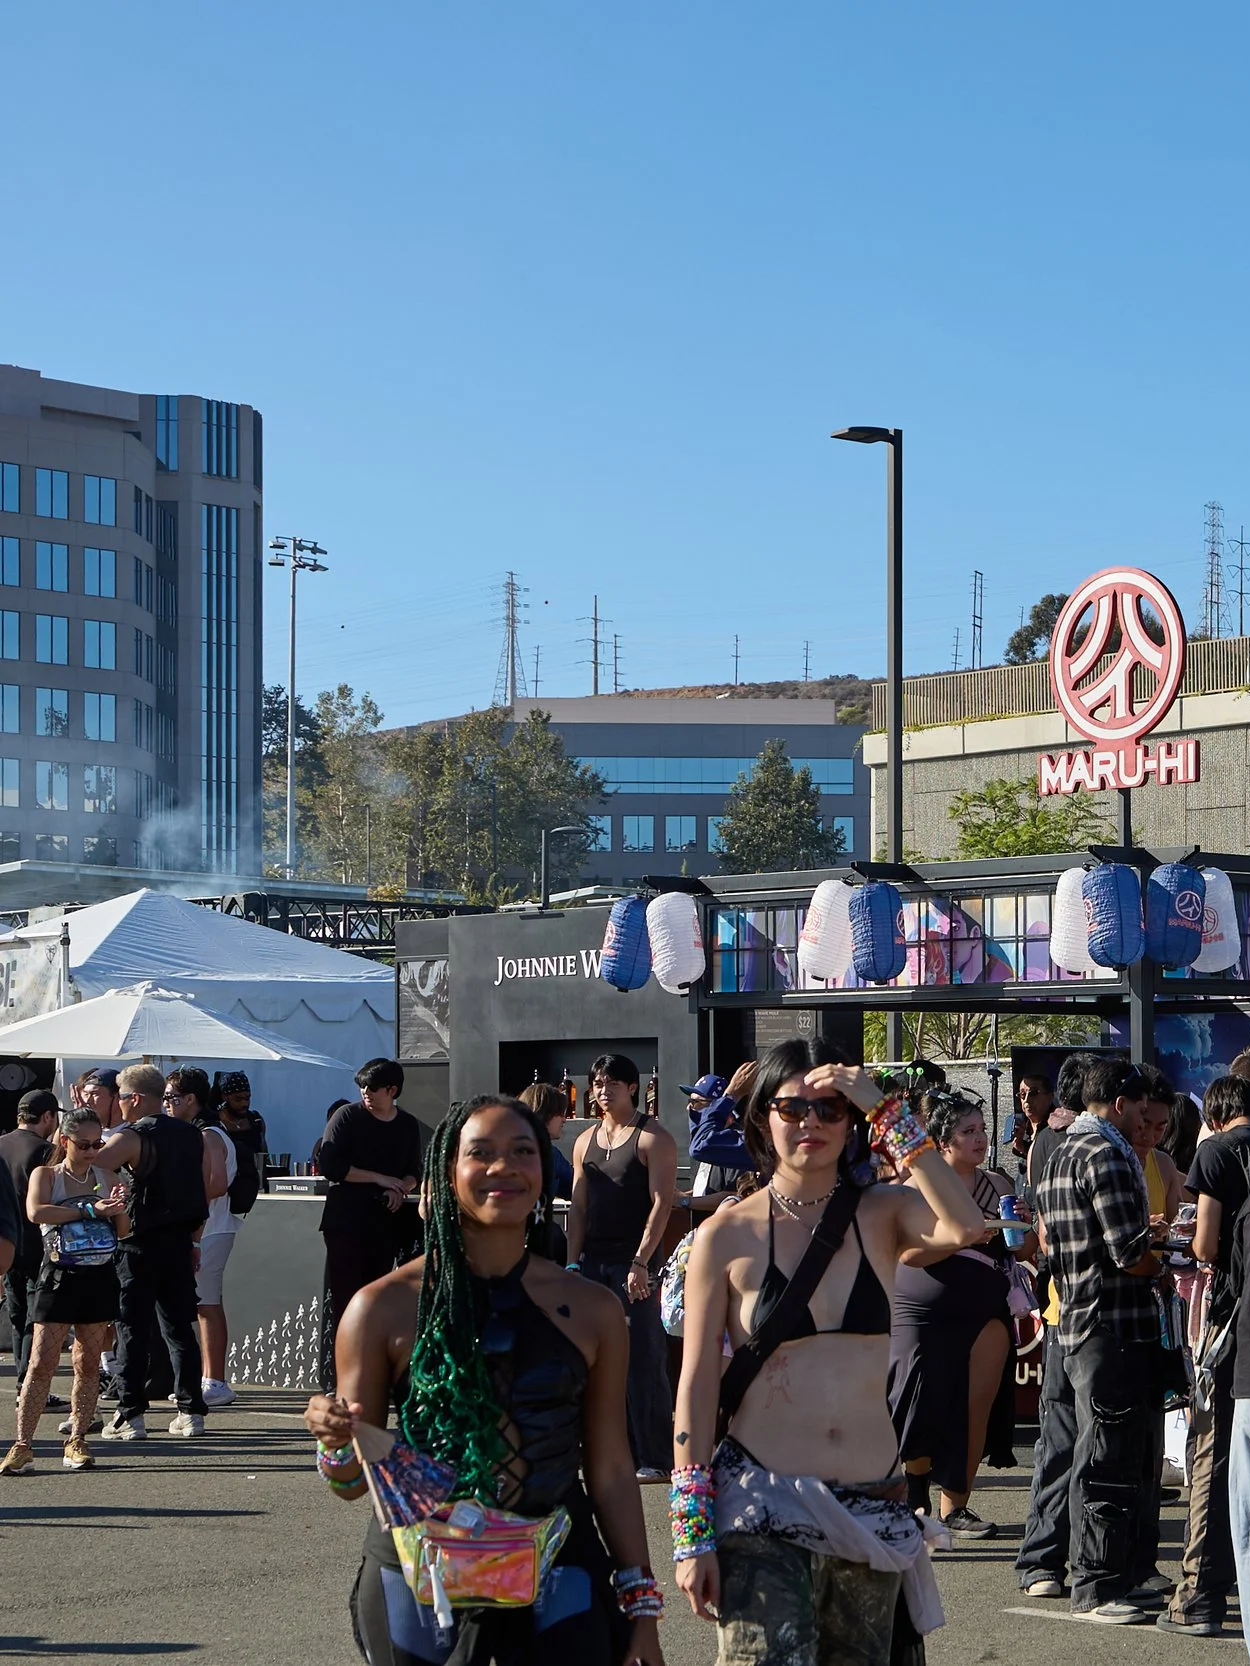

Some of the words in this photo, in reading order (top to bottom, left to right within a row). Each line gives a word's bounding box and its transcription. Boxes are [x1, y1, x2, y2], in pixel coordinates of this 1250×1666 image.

[1039, 741, 1197, 795] MARU-HI
[493, 956, 577, 986] JOHNNIE
[798, 1015, 811, 1029] $22
